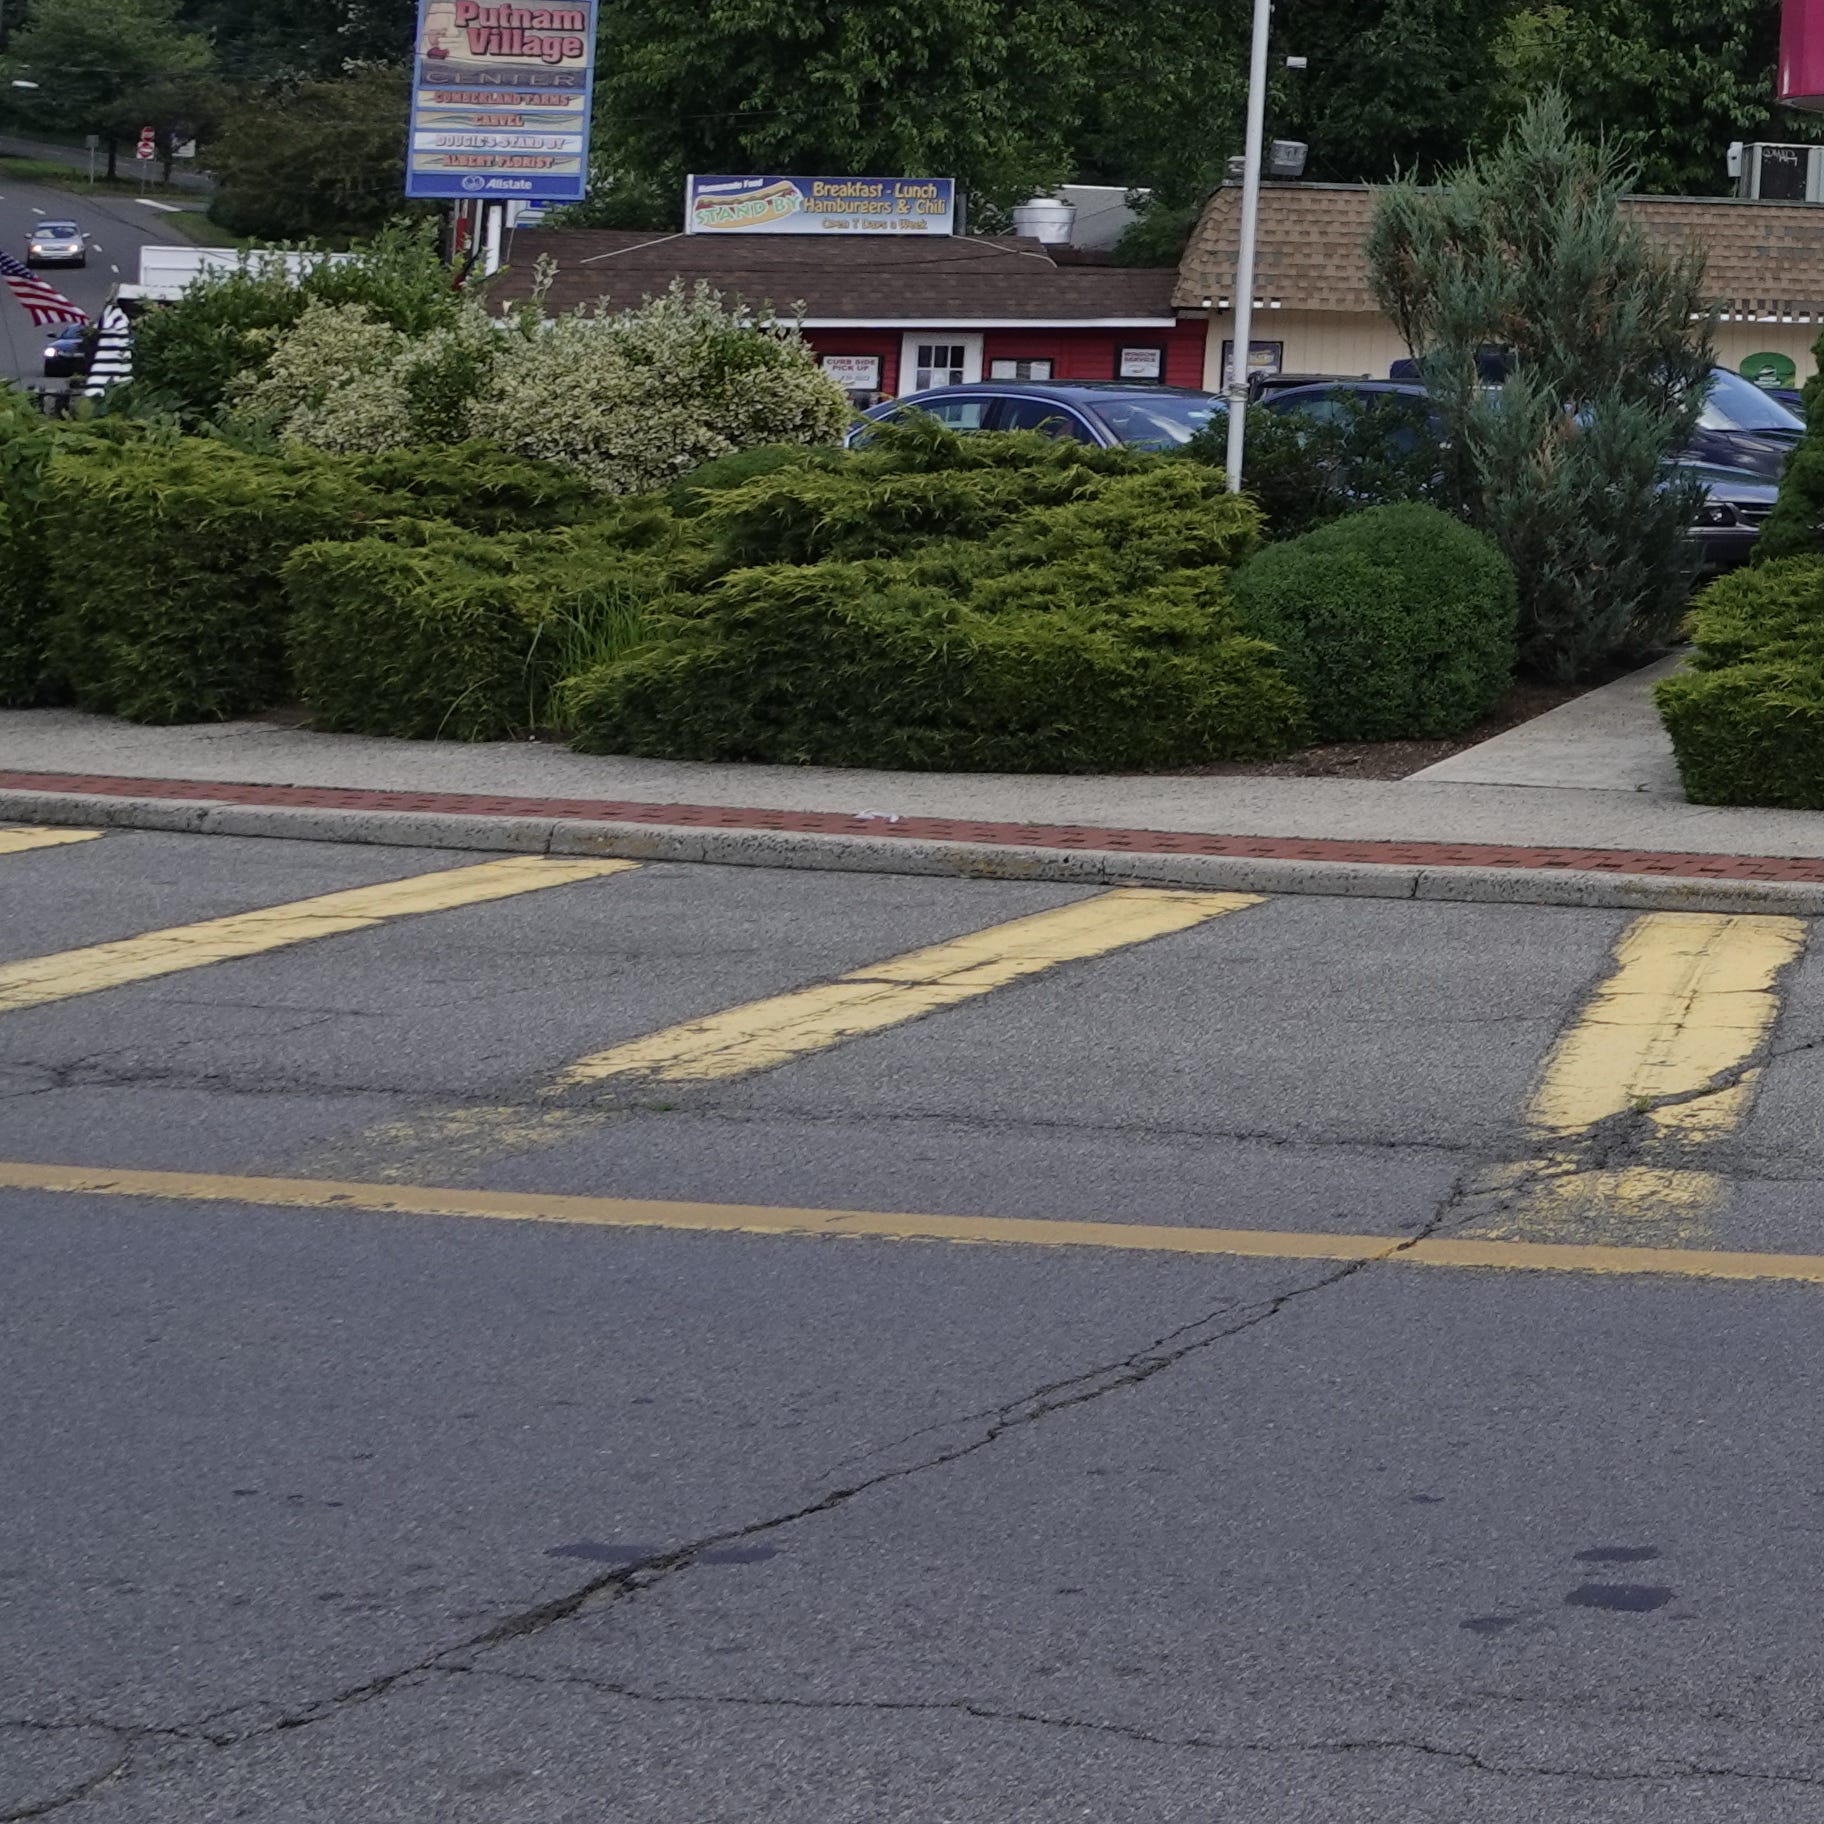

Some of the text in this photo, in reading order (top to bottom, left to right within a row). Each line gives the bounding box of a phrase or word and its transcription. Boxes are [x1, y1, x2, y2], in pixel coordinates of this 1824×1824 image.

[455, 0, 584, 30] Putnam
[467, 27, 583, 64] Village
[426, 71, 576, 86] CENTER
[435, 91, 570, 106] CUMBERLAND FARMS
[475, 115, 525, 126] CARVEL
[498, 137, 544, 149] STAND
[547, 138, 566, 149] BY
[442, 154, 555, 168] ALBERT FLORIST
[486, 178, 532, 190] Allstate
[813, 181, 883, 197] Breakfast
[895, 182, 938, 198] Lunch
[694, 195, 802, 225] STAND BY
[803, 197, 946, 214] Hamburgers & Chili
